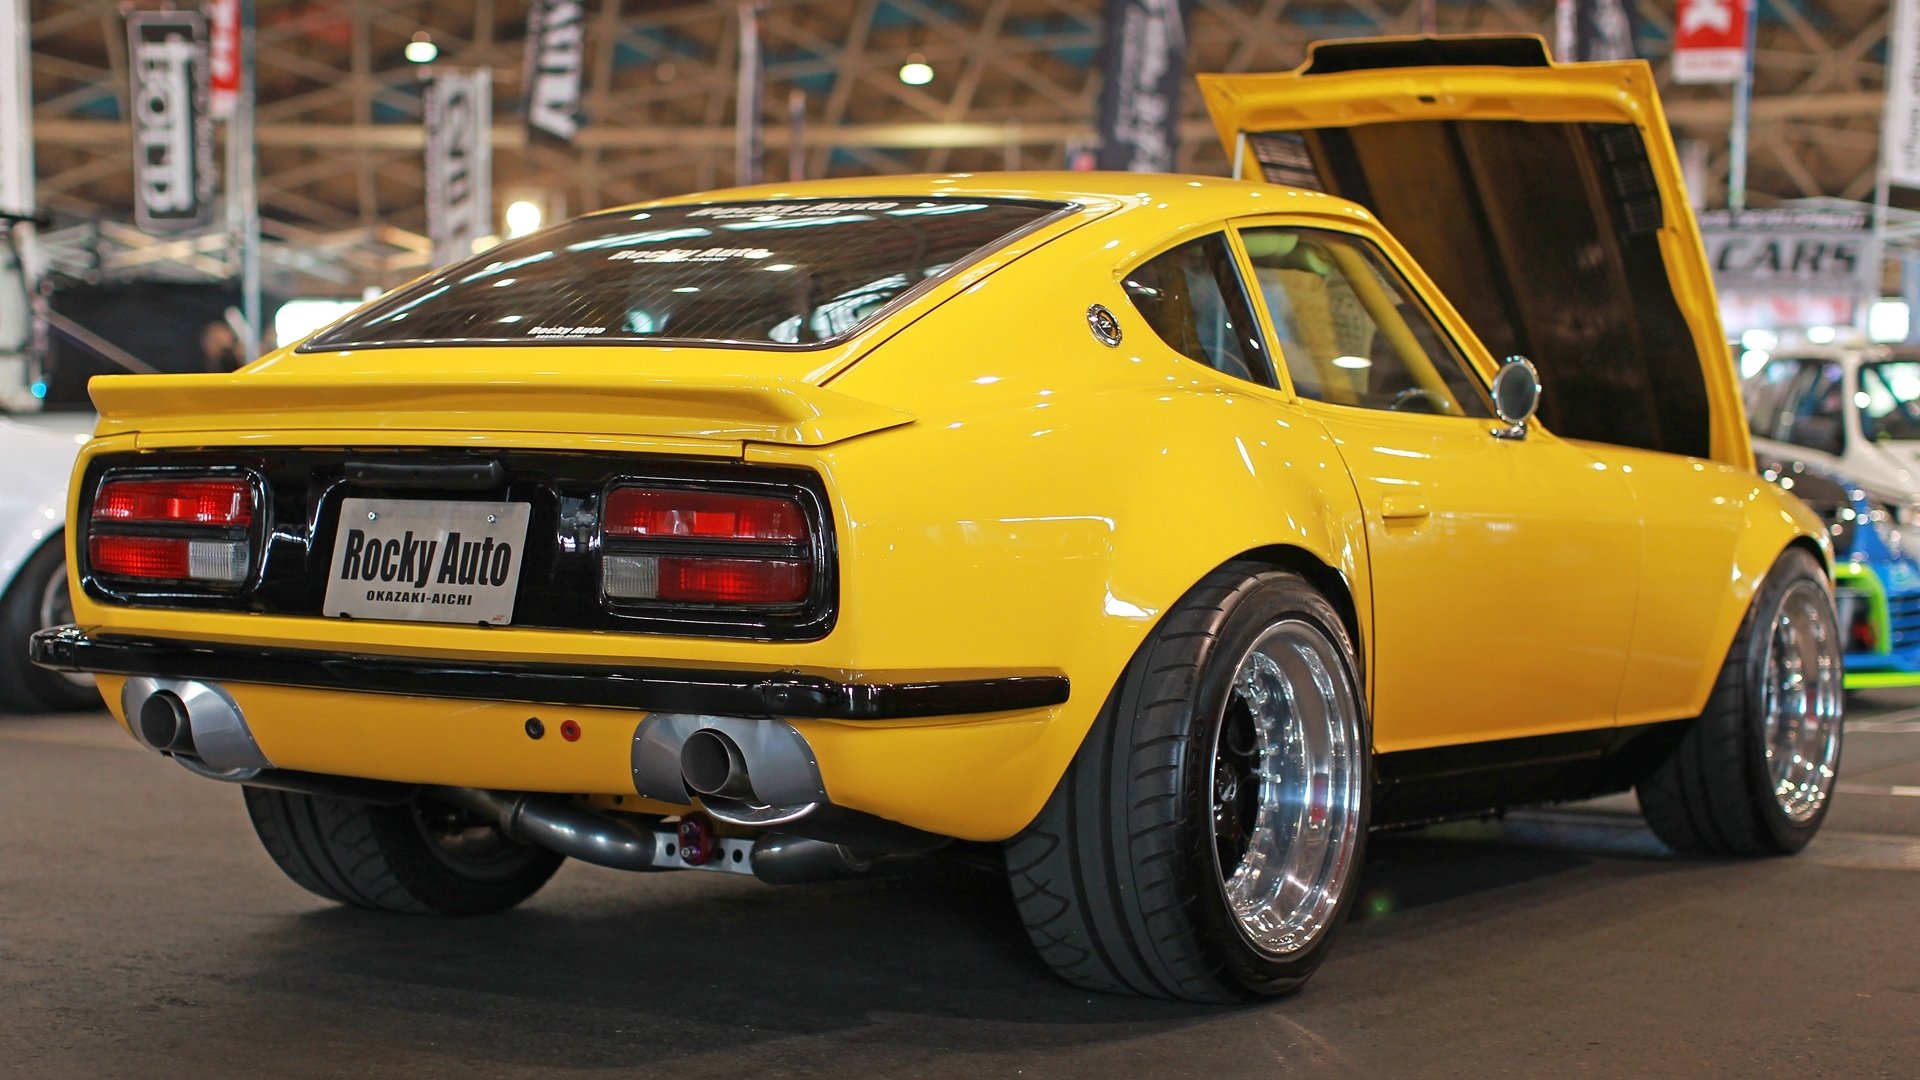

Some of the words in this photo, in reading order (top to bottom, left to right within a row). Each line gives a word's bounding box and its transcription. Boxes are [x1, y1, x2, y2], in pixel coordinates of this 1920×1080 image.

[1715, 238, 1861, 274] CARS
[527, 326, 574, 335] Rocky
[570, 326, 606, 334] Auto
[341, 529, 437, 588] Rocky
[437, 532, 511, 587] Auto
[366, 590, 473, 606] OKAZAKI-AICHI
